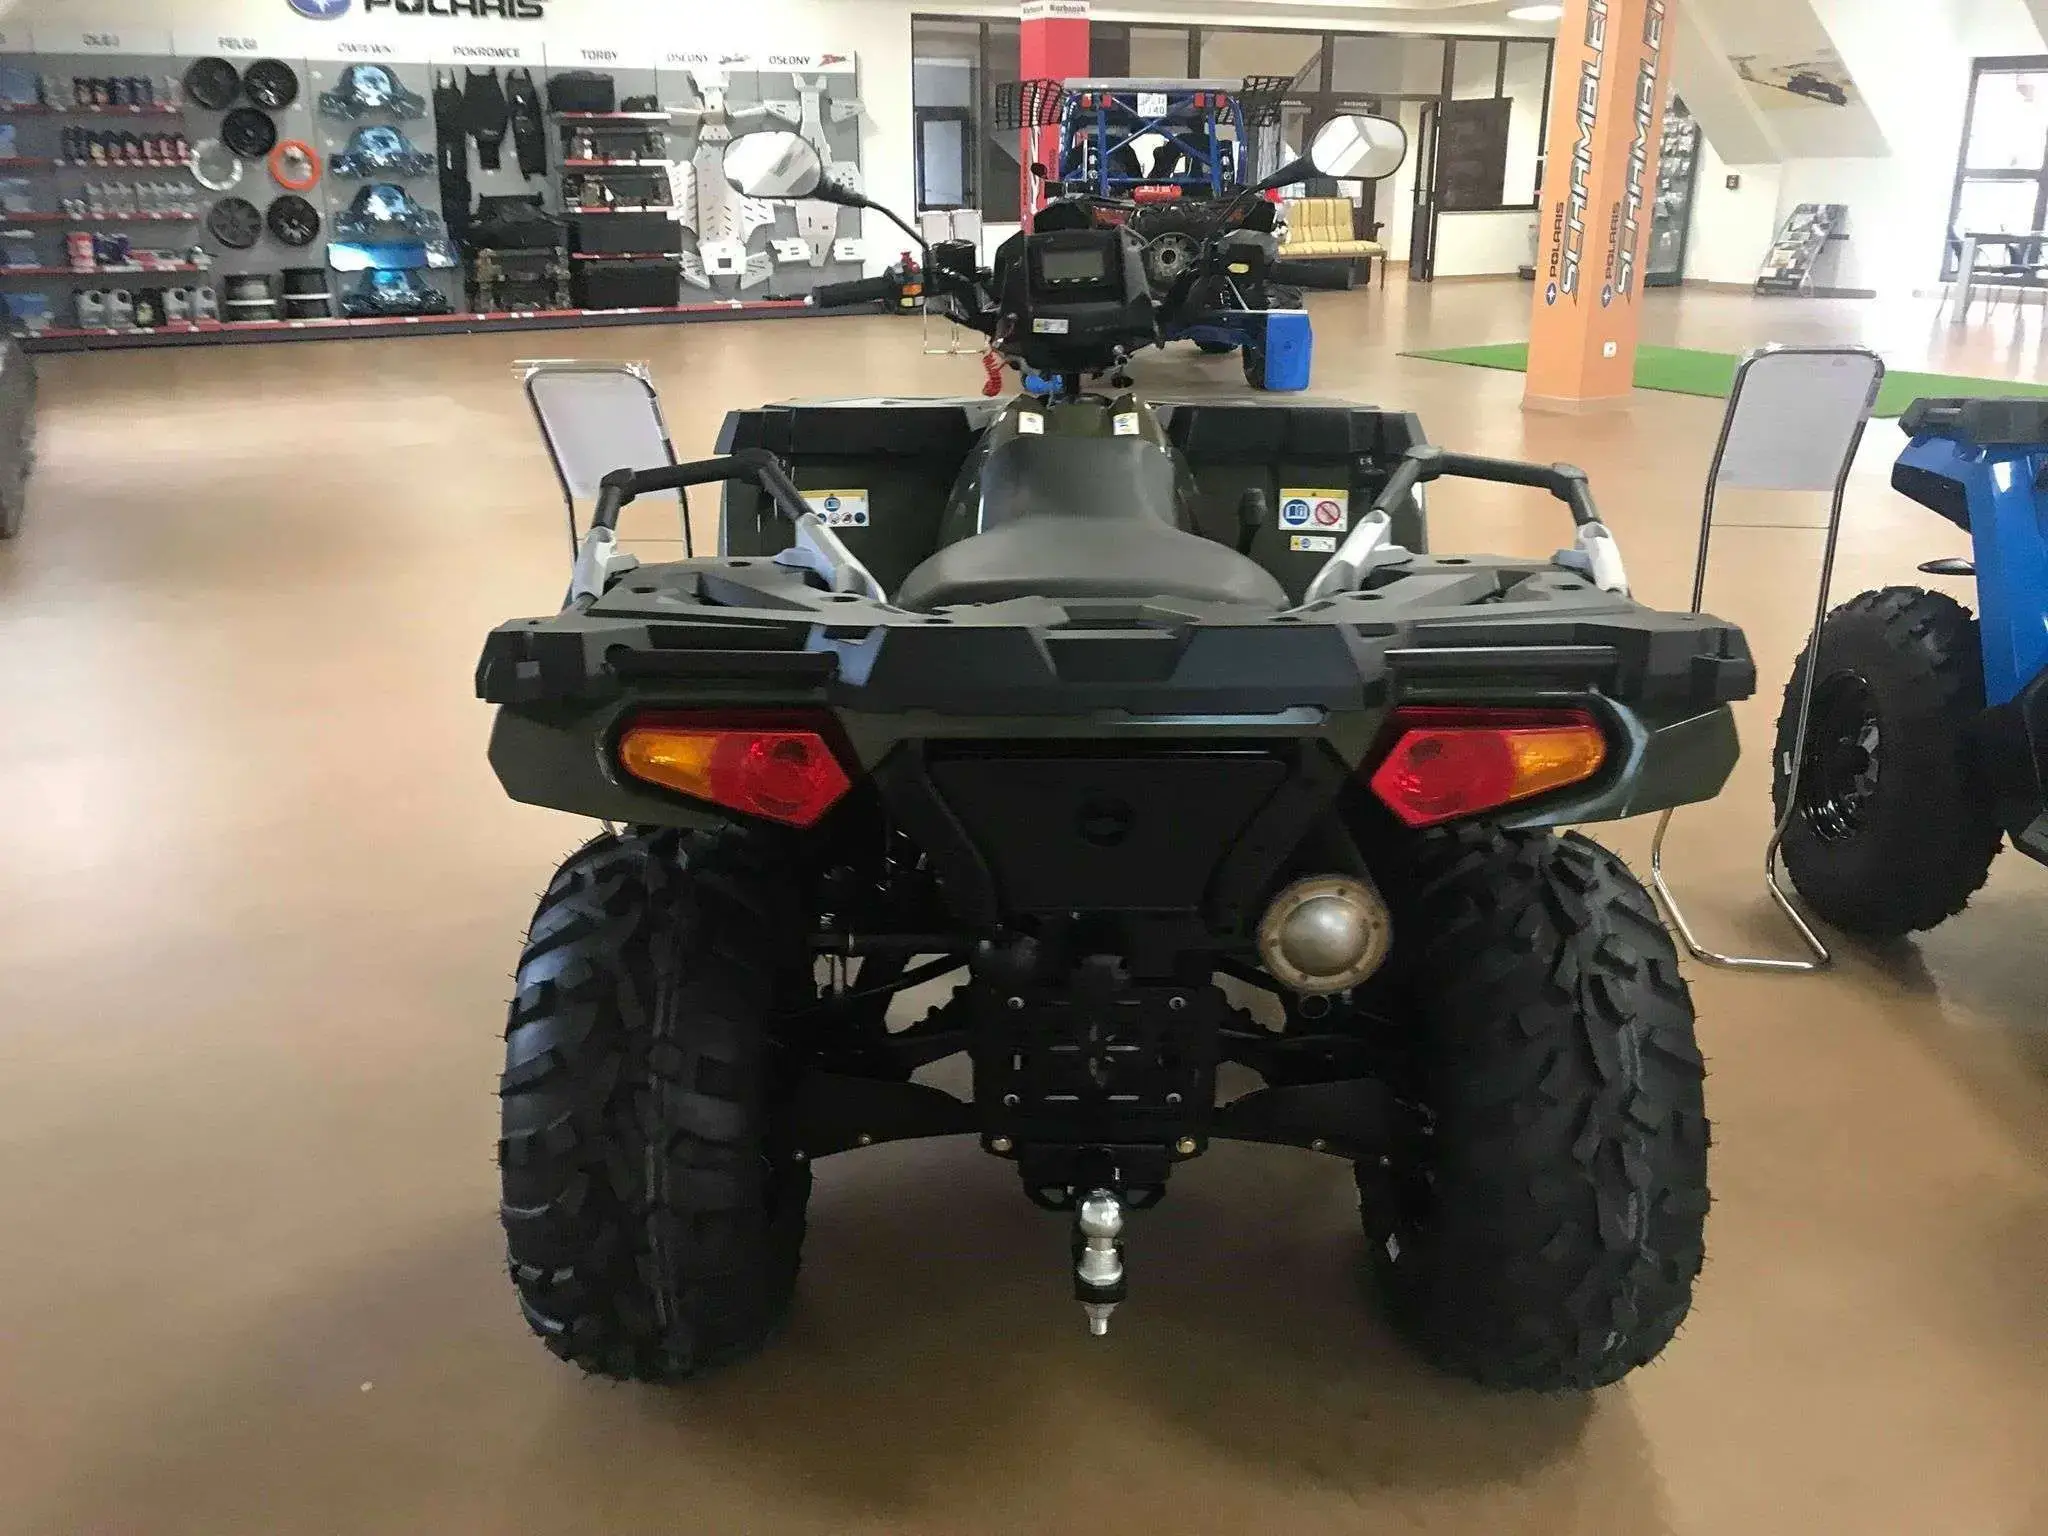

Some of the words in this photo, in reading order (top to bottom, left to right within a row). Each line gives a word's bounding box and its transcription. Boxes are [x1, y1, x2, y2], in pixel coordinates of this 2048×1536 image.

[364, 0, 545, 19] POLARIS
[580, 49, 618, 61] TORBY
[1549, 201, 1565, 278] POLARIS
[1605, 201, 1621, 280] POLARIS
